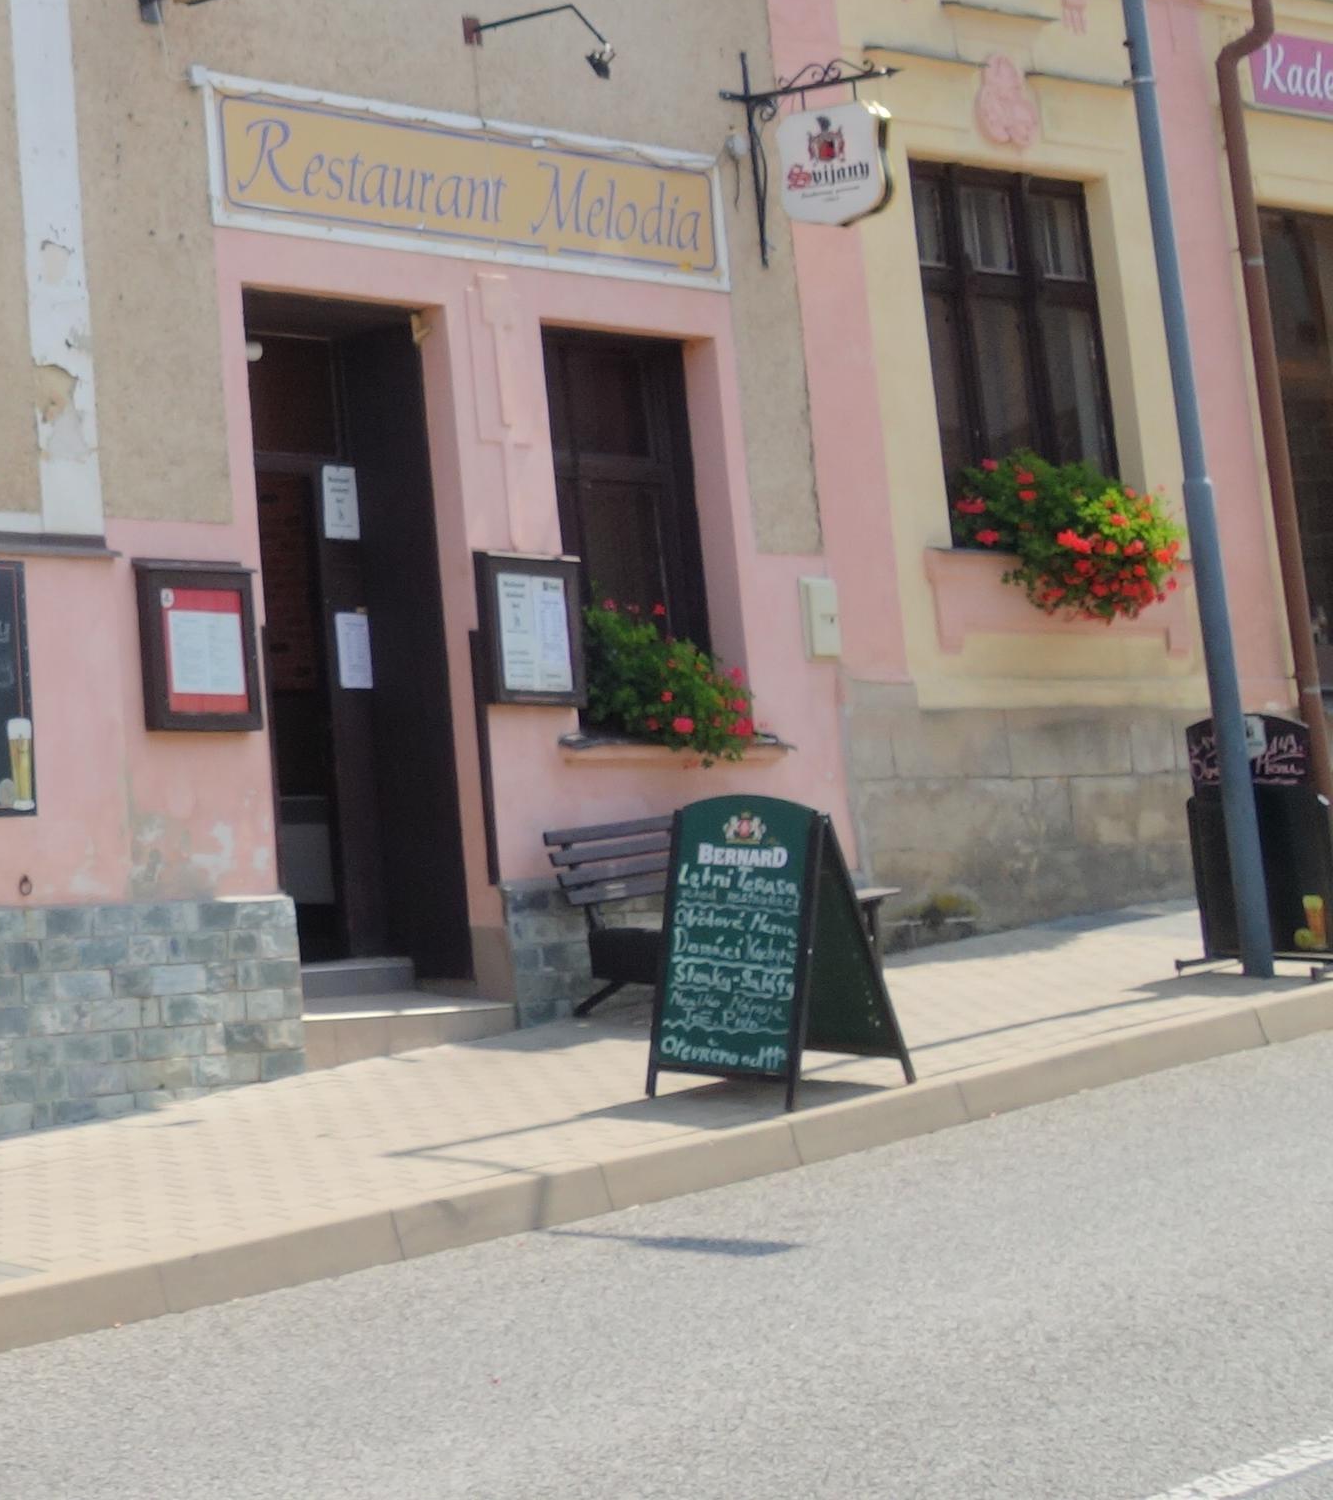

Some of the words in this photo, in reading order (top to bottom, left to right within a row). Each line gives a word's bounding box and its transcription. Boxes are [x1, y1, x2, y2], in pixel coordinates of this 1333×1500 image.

[237, 117, 508, 224] Restaurant
[531, 160, 702, 252] Melodia
[787, 160, 870, 191] Svijany
[697, 842, 789, 869] BERNARD
